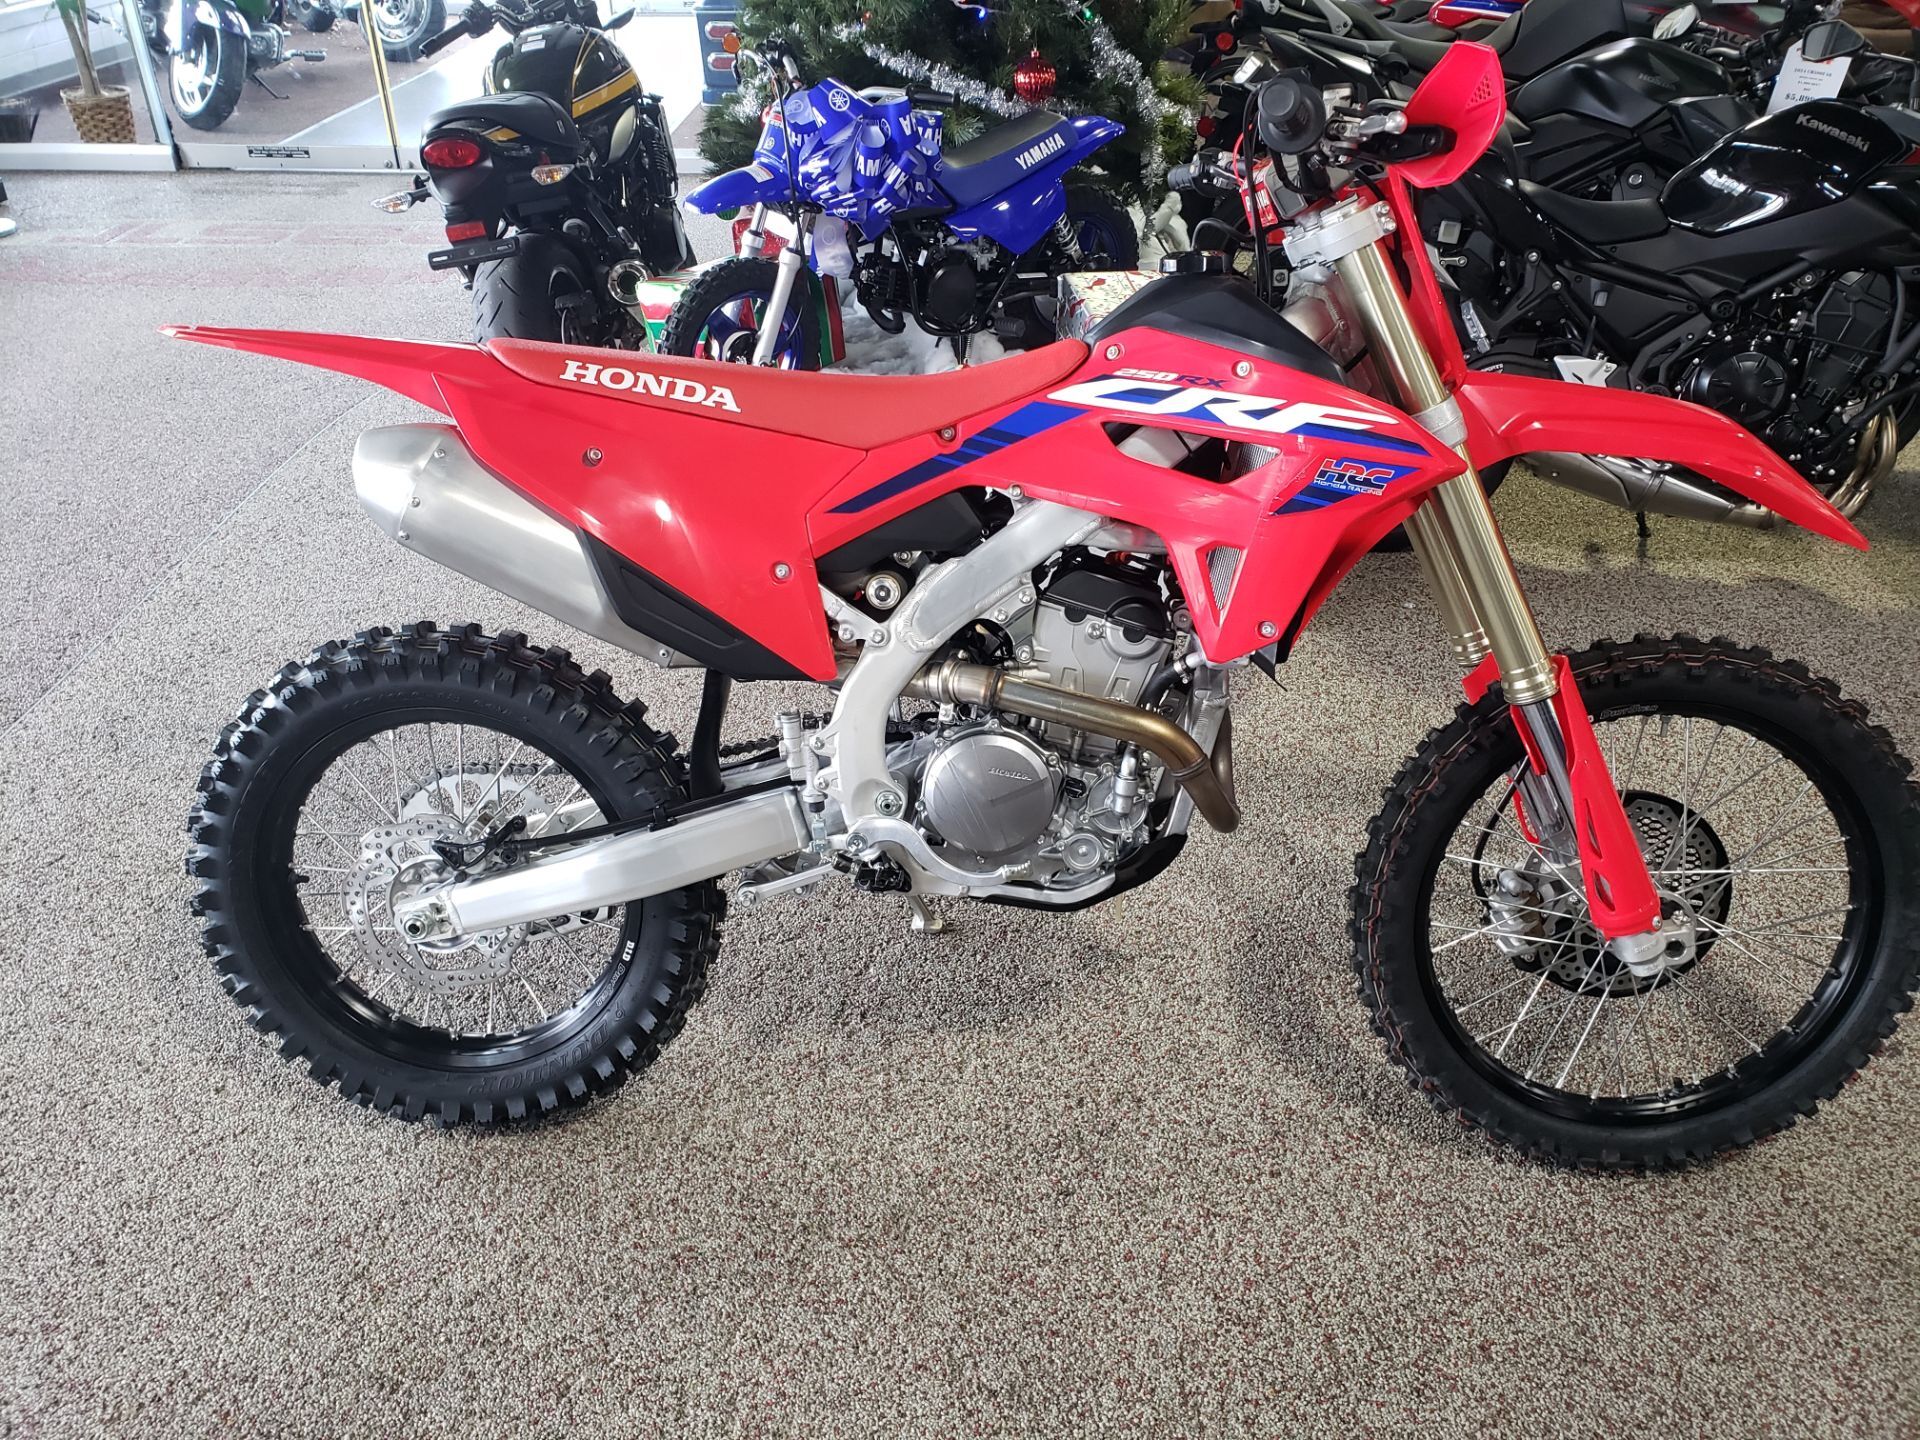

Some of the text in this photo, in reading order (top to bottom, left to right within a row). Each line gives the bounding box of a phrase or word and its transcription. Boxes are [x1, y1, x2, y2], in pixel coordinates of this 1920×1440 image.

[1015, 132, 1065, 170] YAMAHA
[1795, 113, 1870, 152] Kawasaki
[559, 359, 742, 413] HONDA
[1112, 368, 1227, 388] 250RX
[1046, 378, 1400, 433] CRF
[1314, 458, 1395, 491] HRC
[1314, 479, 1383, 496] Honda RACING
